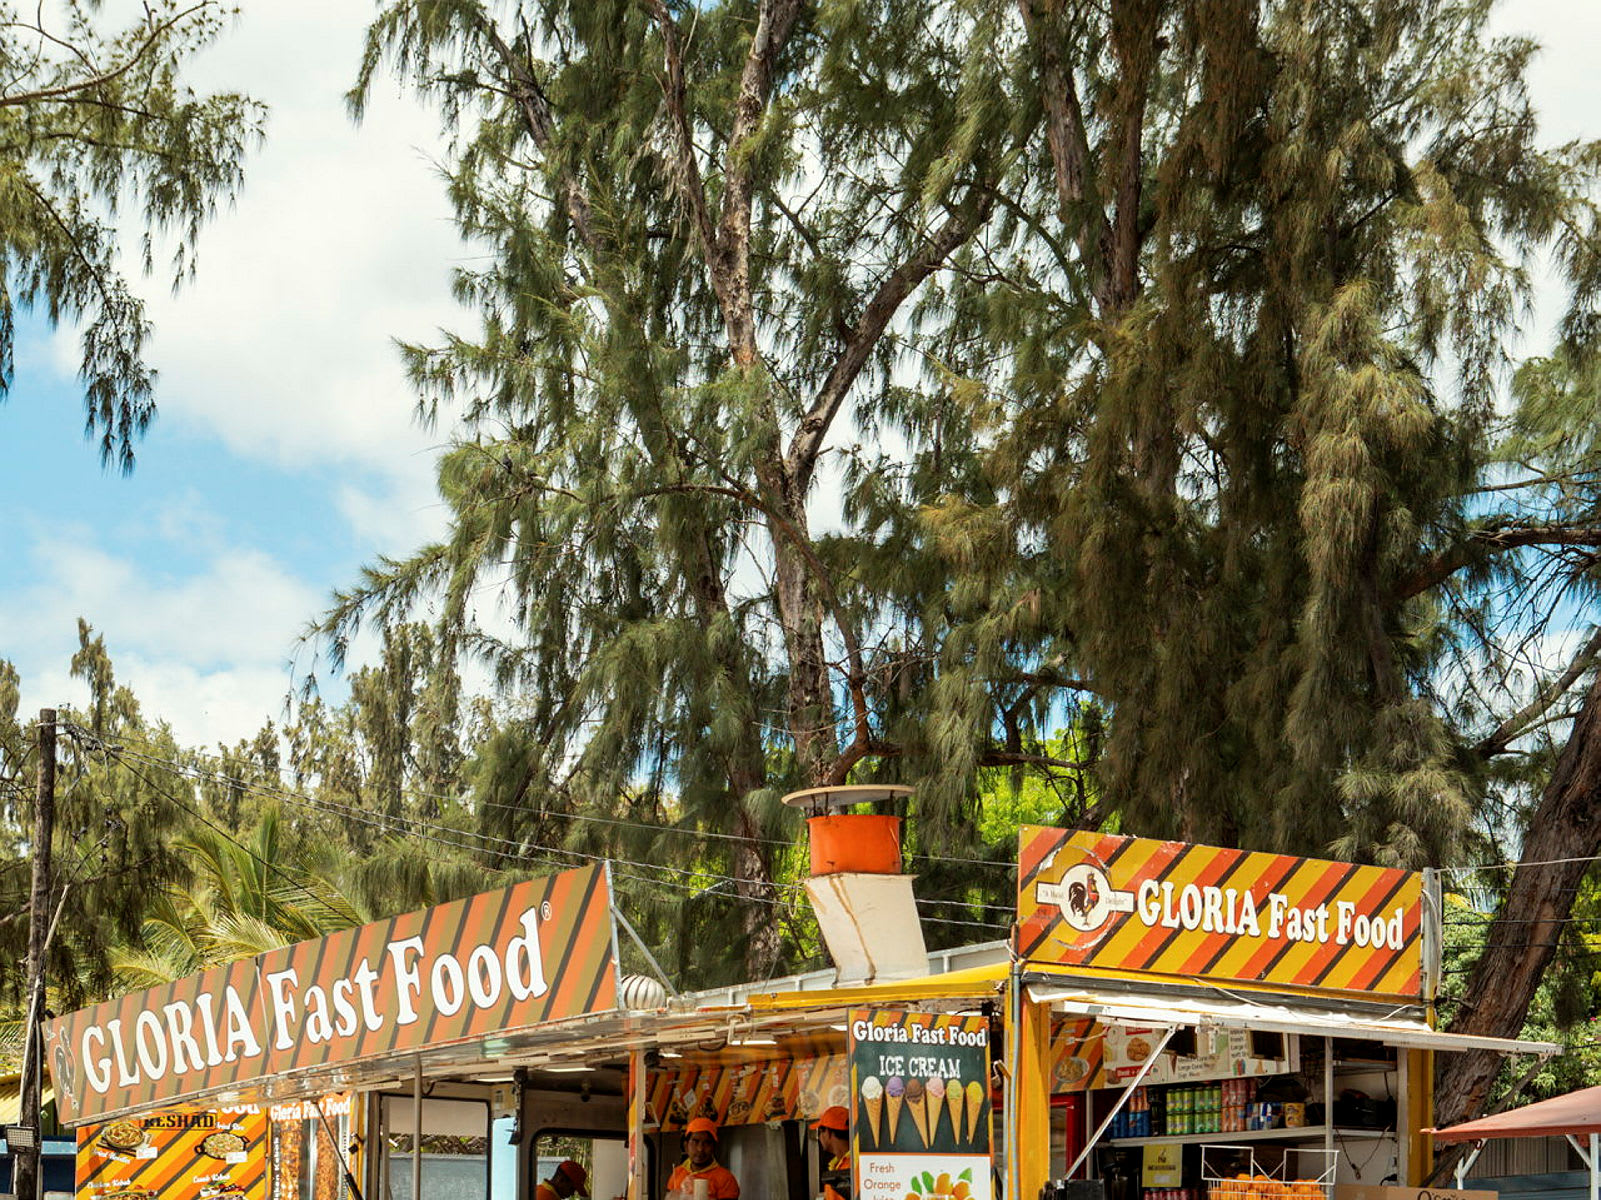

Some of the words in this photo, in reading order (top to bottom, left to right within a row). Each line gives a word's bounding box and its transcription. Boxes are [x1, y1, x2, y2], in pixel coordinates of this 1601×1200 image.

[1137, 878, 1261, 937] GLORIA
[1267, 892, 1329, 943] Fast
[1336, 900, 1404, 950] Food
[82, 985, 261, 1094] GLORIA
[266, 957, 384, 1050] Fast
[387, 906, 549, 1025] Food
[853, 1020, 908, 1043] Gloria
[911, 1023, 946, 1045] Fast
[948, 1026, 988, 1047] Food
[879, 1055, 905, 1076] ICE
[908, 1056, 961, 1078] CREAM
[270, 1102, 301, 1121] Gloria
[325, 1096, 351, 1117] Food
[869, 1163, 895, 1174] Fresh
[863, 1178, 901, 1192] Orange
